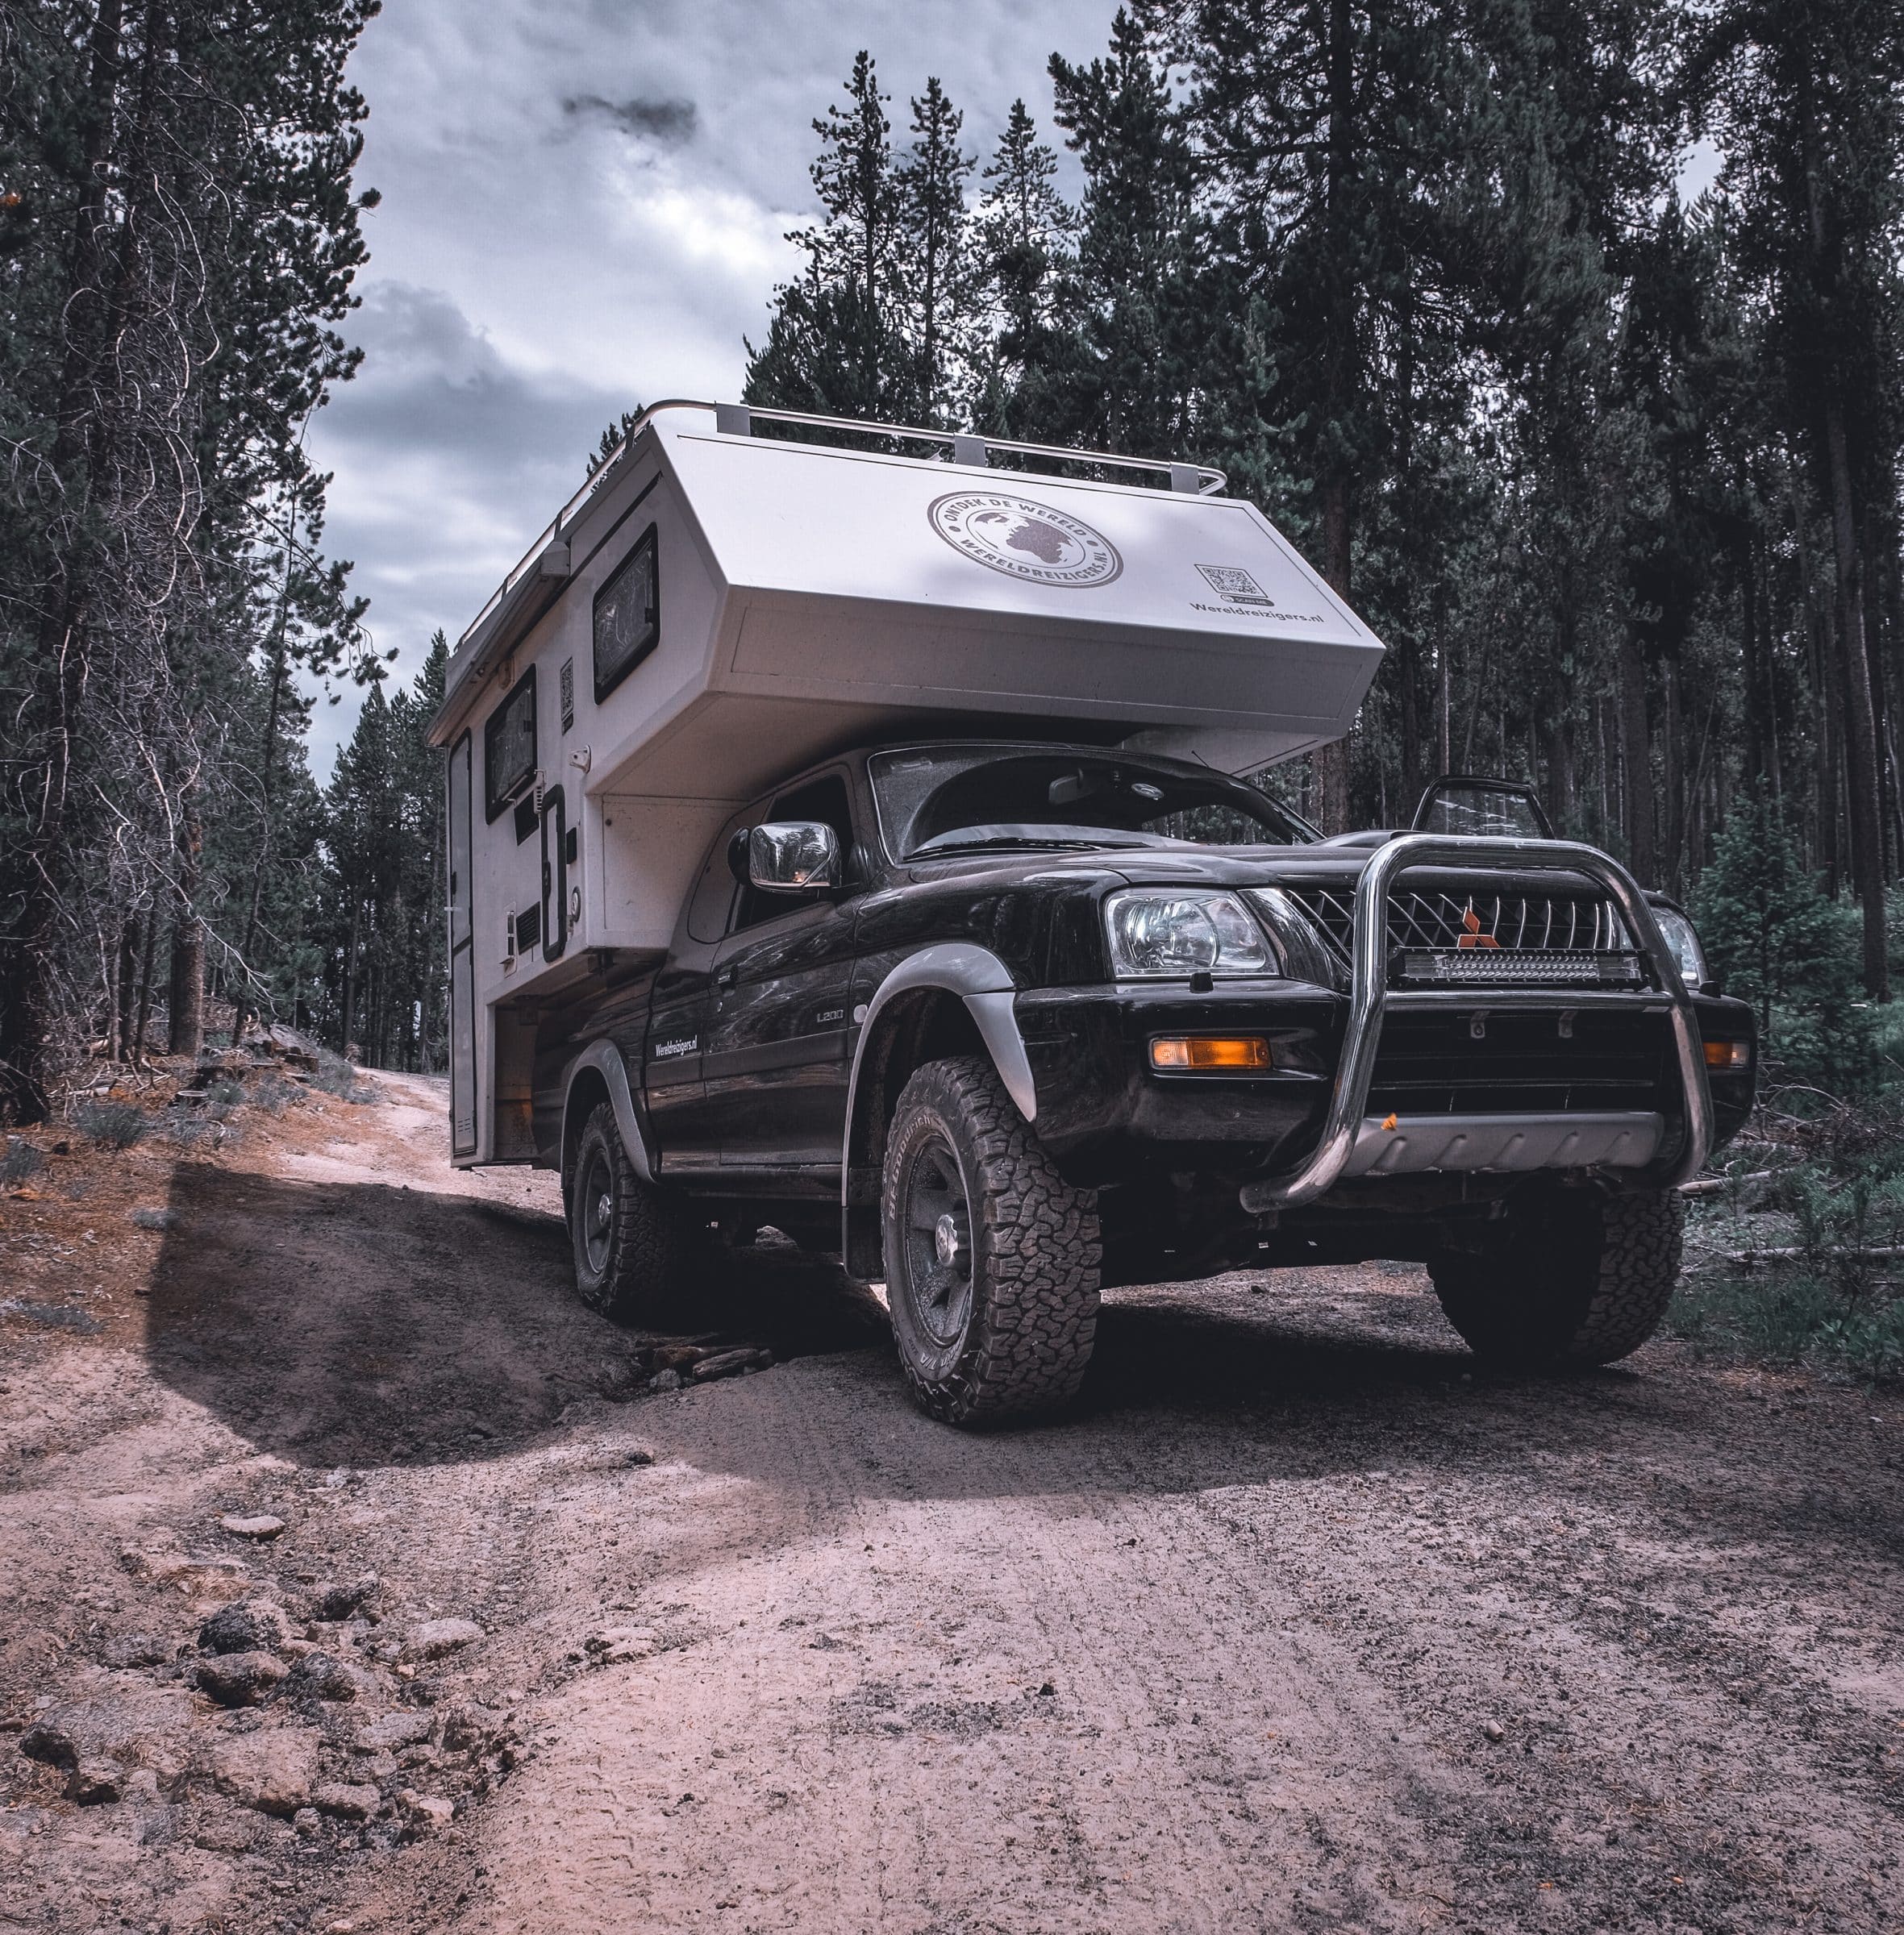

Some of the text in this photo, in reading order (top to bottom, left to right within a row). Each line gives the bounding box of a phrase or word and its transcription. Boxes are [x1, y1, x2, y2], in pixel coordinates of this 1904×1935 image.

[944, 498, 1087, 537] ONTDEK DE WERELD
[960, 539, 1107, 580] WERELDREIZIGERS.NL
[1189, 602, 1325, 622] Wereldreizigers.nl
[817, 1009, 844, 1023] L200
[656, 1034, 697, 1057] Wereldreizigers.nl
